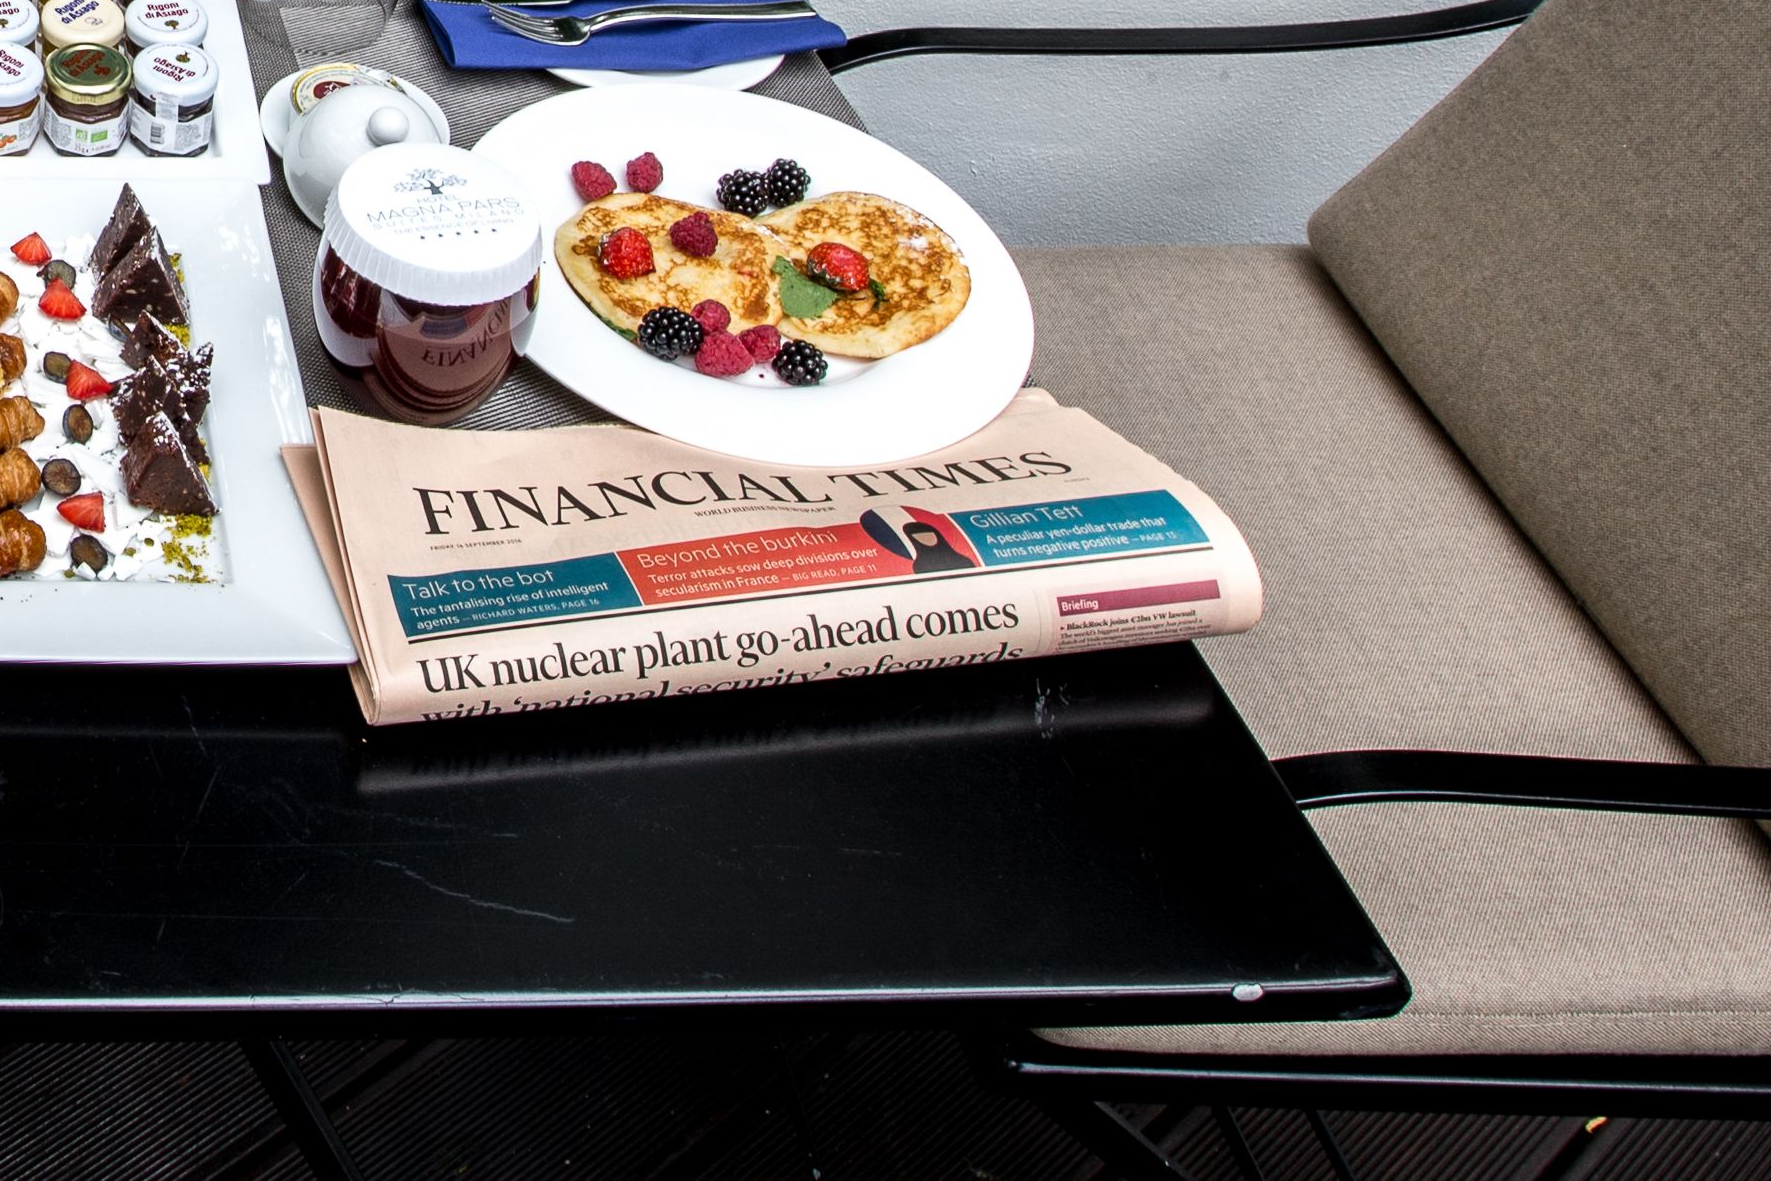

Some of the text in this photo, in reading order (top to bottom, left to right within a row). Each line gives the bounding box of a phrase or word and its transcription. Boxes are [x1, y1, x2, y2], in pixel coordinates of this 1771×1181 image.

[147, 2, 180, 11] Rigoni
[156, 9, 189, 18] Asiago
[367, 197, 520, 223] MAGNA PARS
[417, 193, 458, 204] HOTEL
[412, 451, 1072, 536] FINANCIAL TIMES
[969, 504, 1084, 529] Gillian Tett
[986, 516, 1167, 545] A peculiar yen-dollar trade that
[429, 543, 454, 551] FRIDAY
[465, 539, 505, 548] SEPTEMBER
[636, 530, 838, 570] Beyond the burkini
[994, 547, 1027, 559] turns
[1028, 540, 1080, 557] negative
[1081, 535, 1130, 551] positive
[1140, 533, 1165, 542] PAGE
[647, 547, 878, 585] Terror attacks sow deep divisions over
[655, 563, 877, 598] secularism in France BIG READ, PAGE 11
[402, 569, 554, 601] Talk to the bot
[410, 582, 609, 617] The tantalising rise of intelligent
[416, 597, 600, 631] agents RICHARD WATERS, PAGE 16
[1061, 598, 1099, 612] Briefing
[416, 654, 486, 694] UK
[490, 642, 626, 688] nuclear
[633, 630, 731, 680] plant
[736, 605, 900, 668] go-ahead
[906, 603, 1020, 639] comes
[420, 699, 502, 721] with
[836, 641, 1024, 677] safeguards
